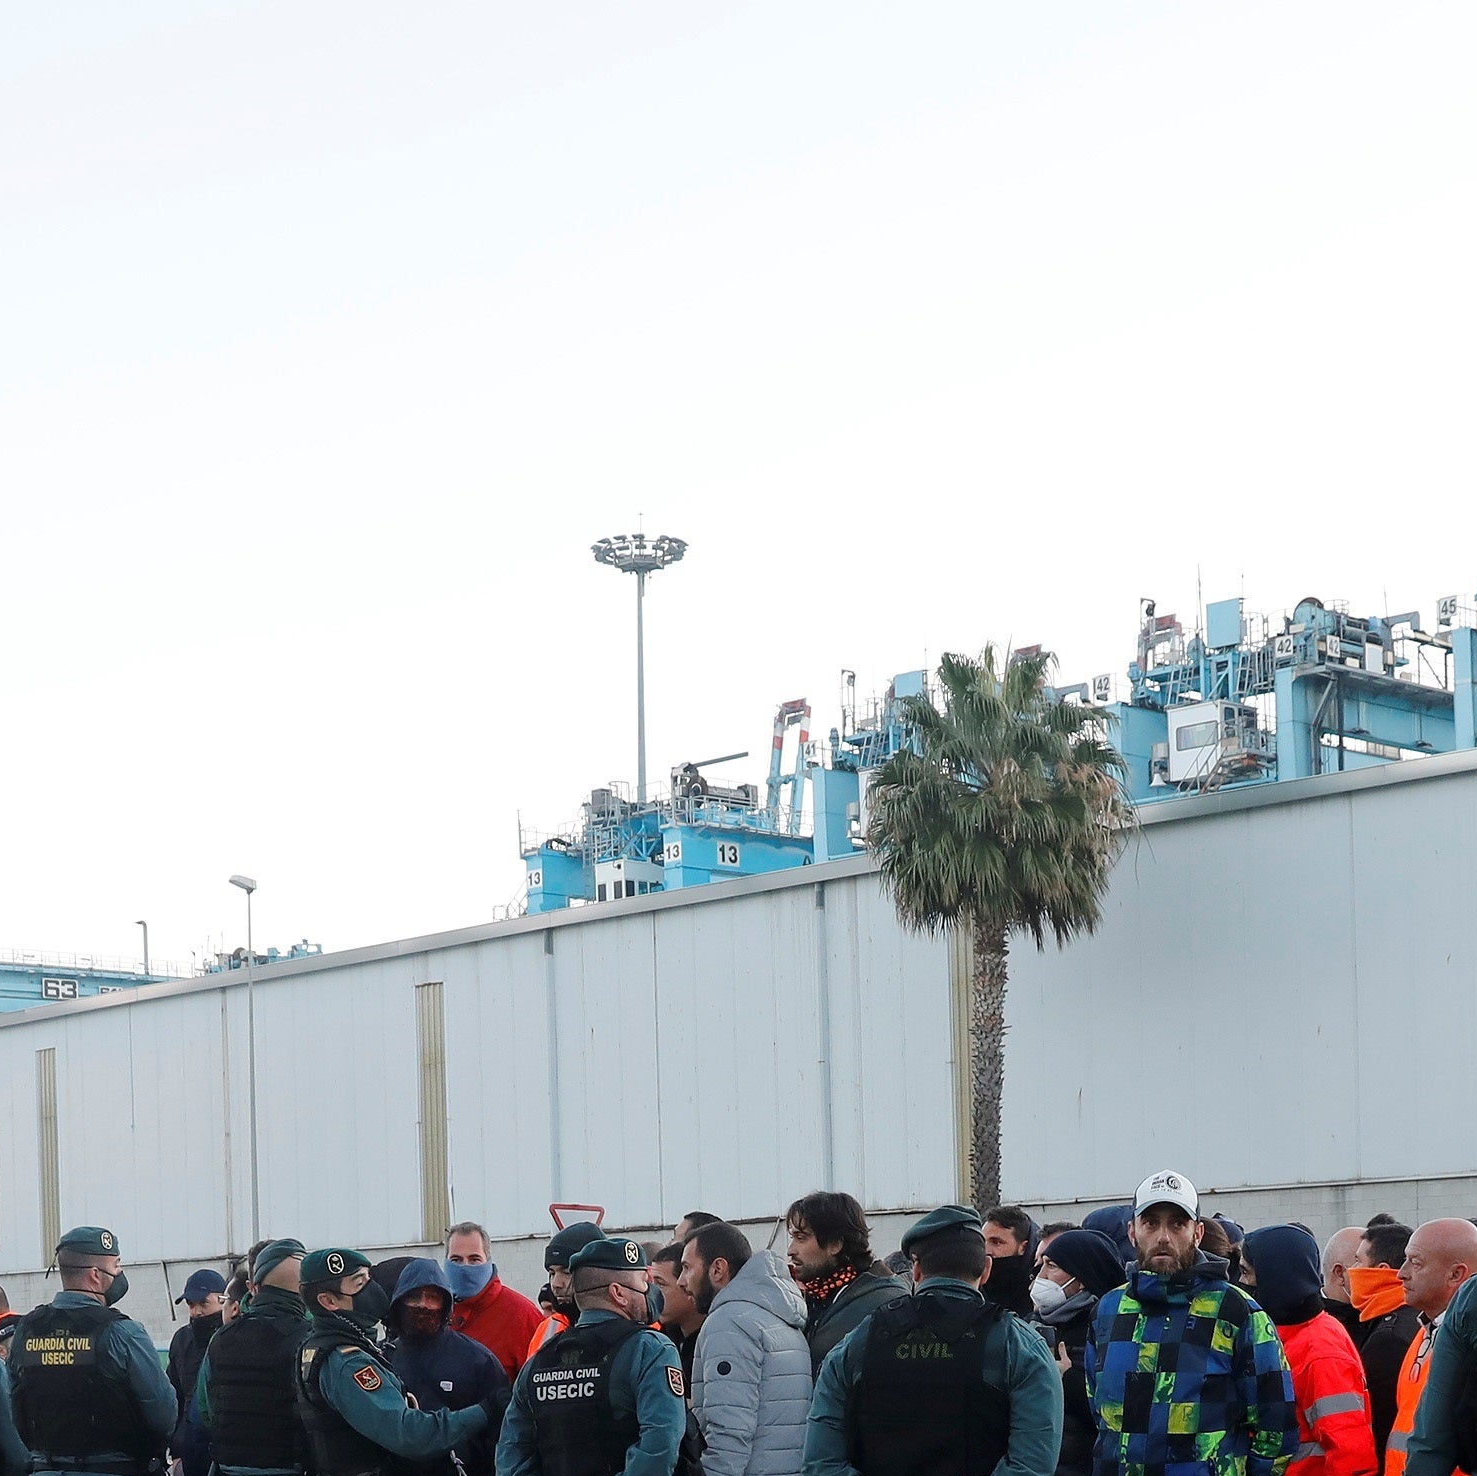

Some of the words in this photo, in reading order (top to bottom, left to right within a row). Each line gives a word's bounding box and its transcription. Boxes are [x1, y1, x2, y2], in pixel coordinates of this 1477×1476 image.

[1439, 599, 1456, 615] 45
[1276, 639, 1293, 655] 42
[1327, 638, 1339, 655] 42
[1096, 676, 1110, 692] 42
[804, 743, 817, 757] 41
[665, 843, 680, 859] 13
[719, 844, 738, 864] 13
[527, 872, 541, 886] 13
[44, 979, 77, 999] 63
[26, 1338, 65, 1352] GUARDIA
[67, 1337, 91, 1351] CIVIL
[894, 1342, 955, 1360] CIVIL
[41, 1351, 74, 1365] USECIC
[533, 1370, 574, 1383] GUARDIA
[576, 1368, 601, 1379] CIVIL
[536, 1382, 595, 1402] USECIC
